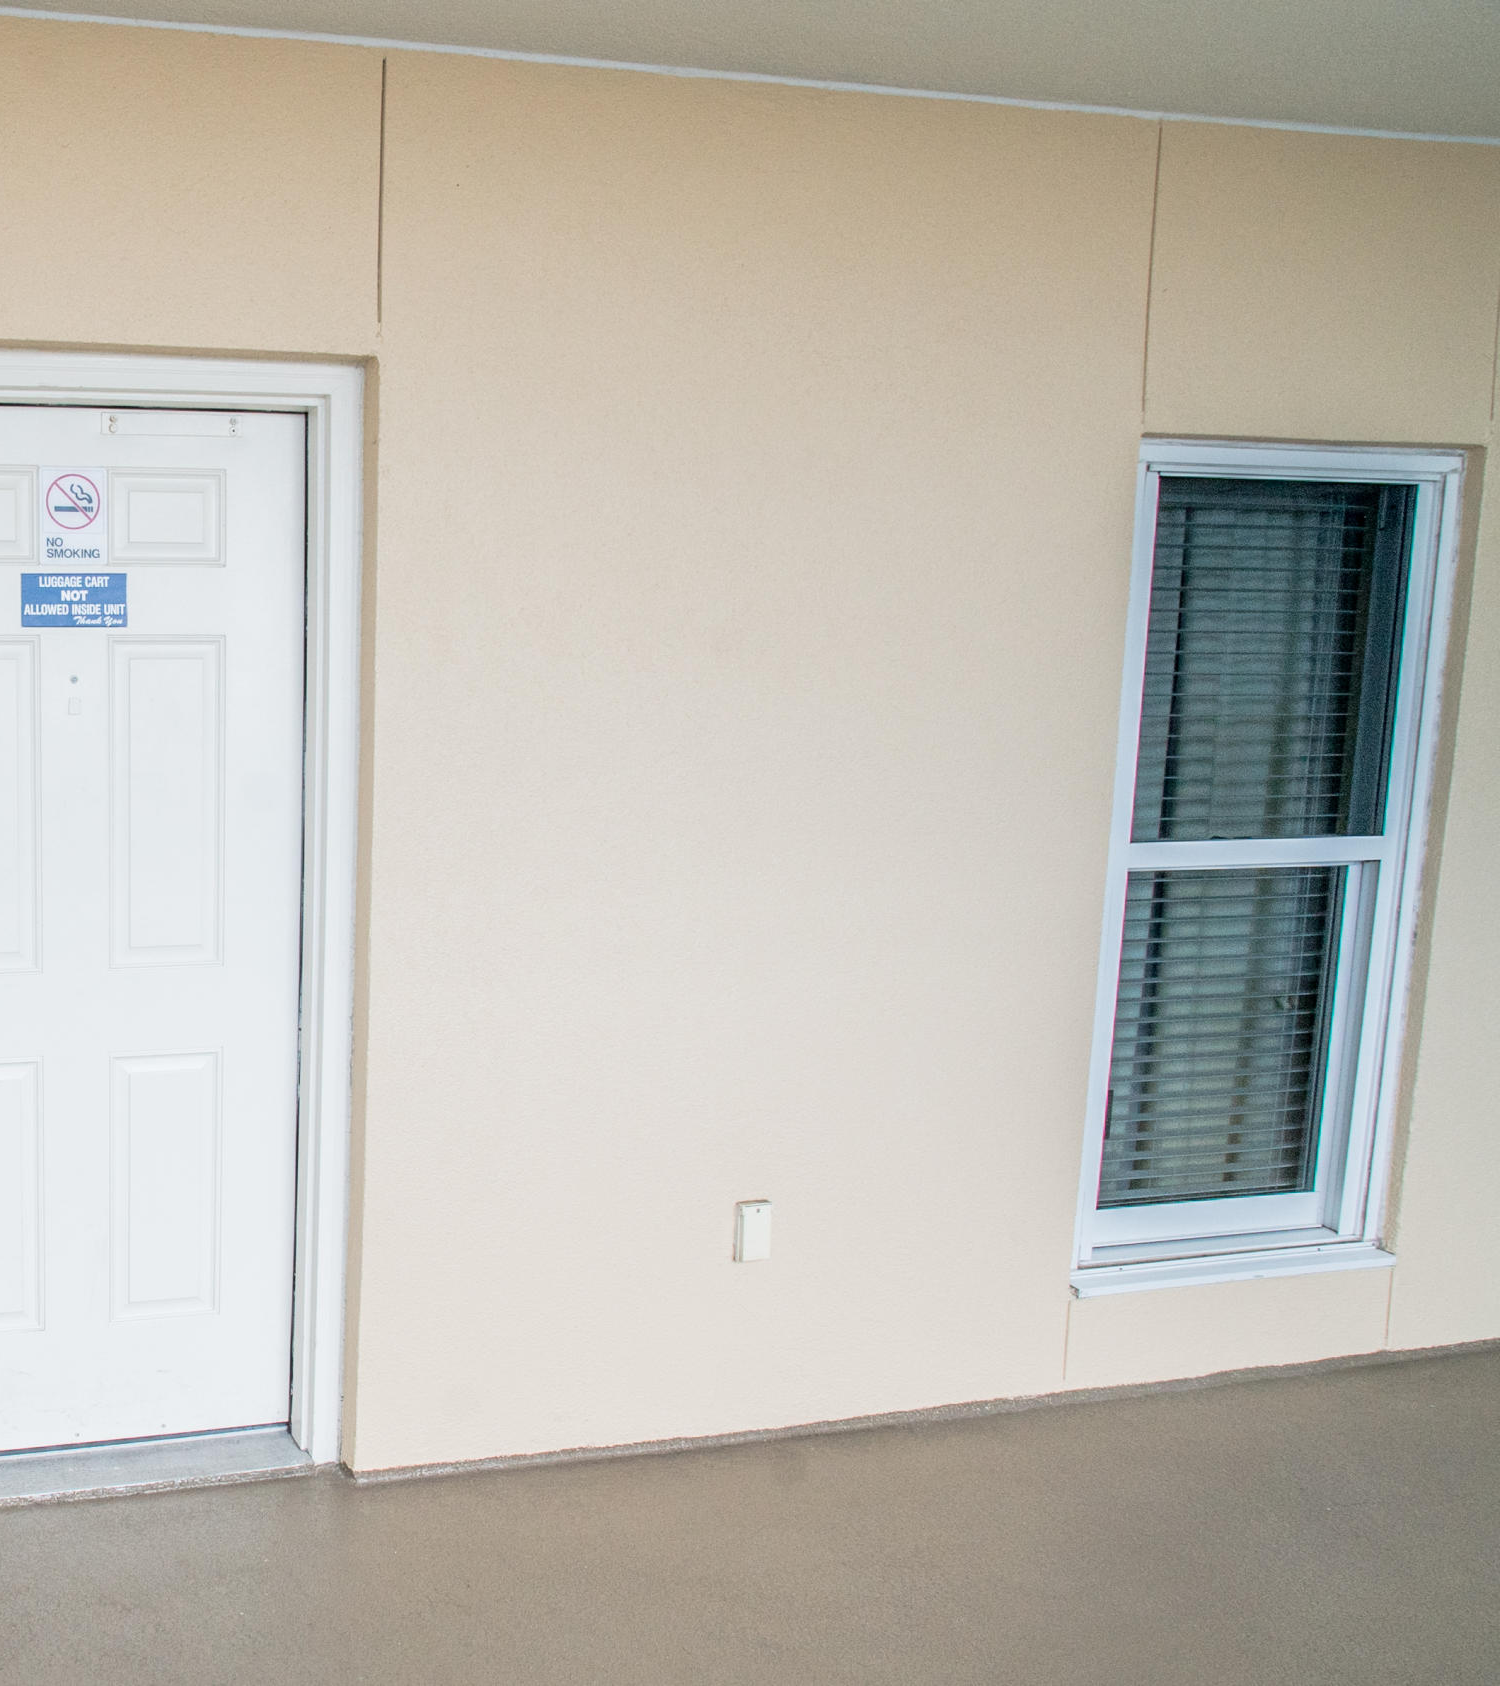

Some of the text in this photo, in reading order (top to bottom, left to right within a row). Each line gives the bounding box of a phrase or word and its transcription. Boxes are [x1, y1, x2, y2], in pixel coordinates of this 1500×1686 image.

[46, 537, 64, 547] NO
[46, 548, 101, 559] SMOKING
[38, 576, 110, 588] LUGGAGE CART
[60, 590, 89, 602] NOT
[24, 604, 126, 616] ALLOWED INSIDE UNIT
[73, 615, 124, 627] Thank You
